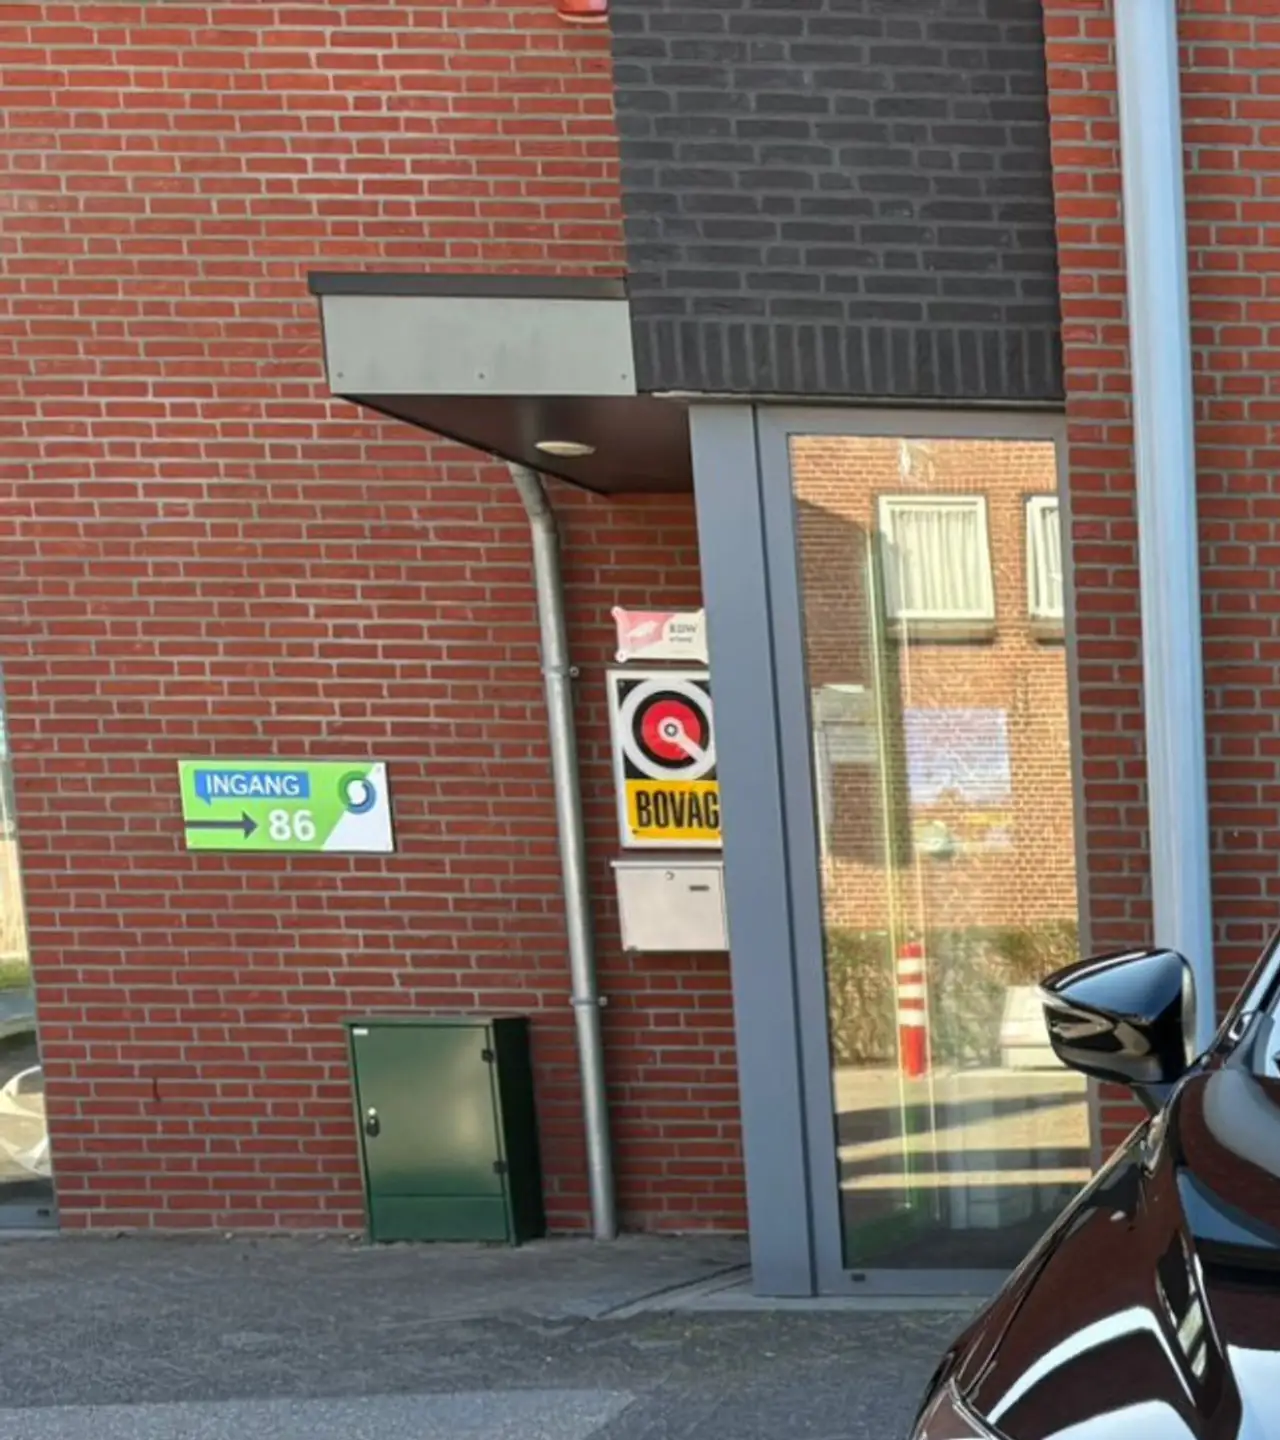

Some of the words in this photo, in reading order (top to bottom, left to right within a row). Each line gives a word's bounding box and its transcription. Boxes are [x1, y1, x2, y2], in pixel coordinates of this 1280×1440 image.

[206, 775, 300, 796] INGANG
[268, 809, 316, 842] 86
[636, 790, 719, 829] BOVAG
